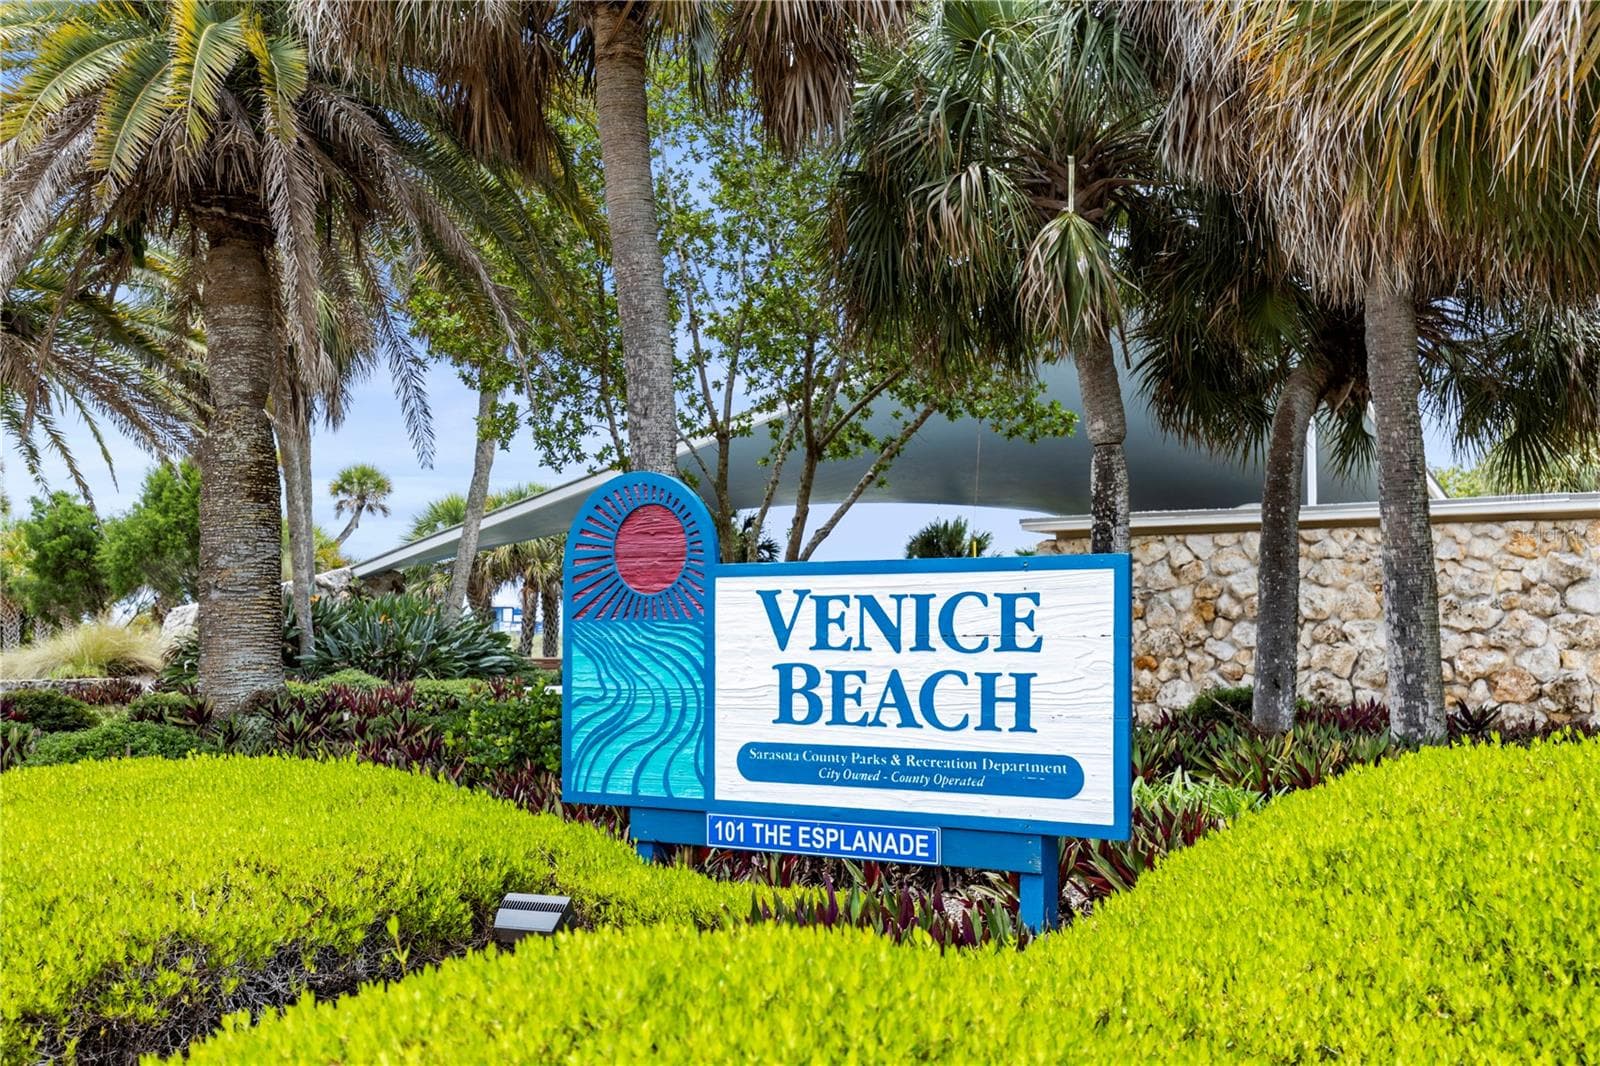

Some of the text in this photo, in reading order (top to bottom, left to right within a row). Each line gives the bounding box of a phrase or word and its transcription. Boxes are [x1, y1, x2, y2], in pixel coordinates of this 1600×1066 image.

[756, 589, 1043, 654] VENICE
[772, 663, 1037, 733] BEACH
[749, 748, 1067, 775] Sarasota County Parks & Recreation Department
[818, 767, 841, 782] City
[842, 769, 881, 782] Owned
[891, 771, 931, 787] County
[933, 773, 986, 788] Operated
[714, 820, 929, 857] 101 THE ESPLANADE
